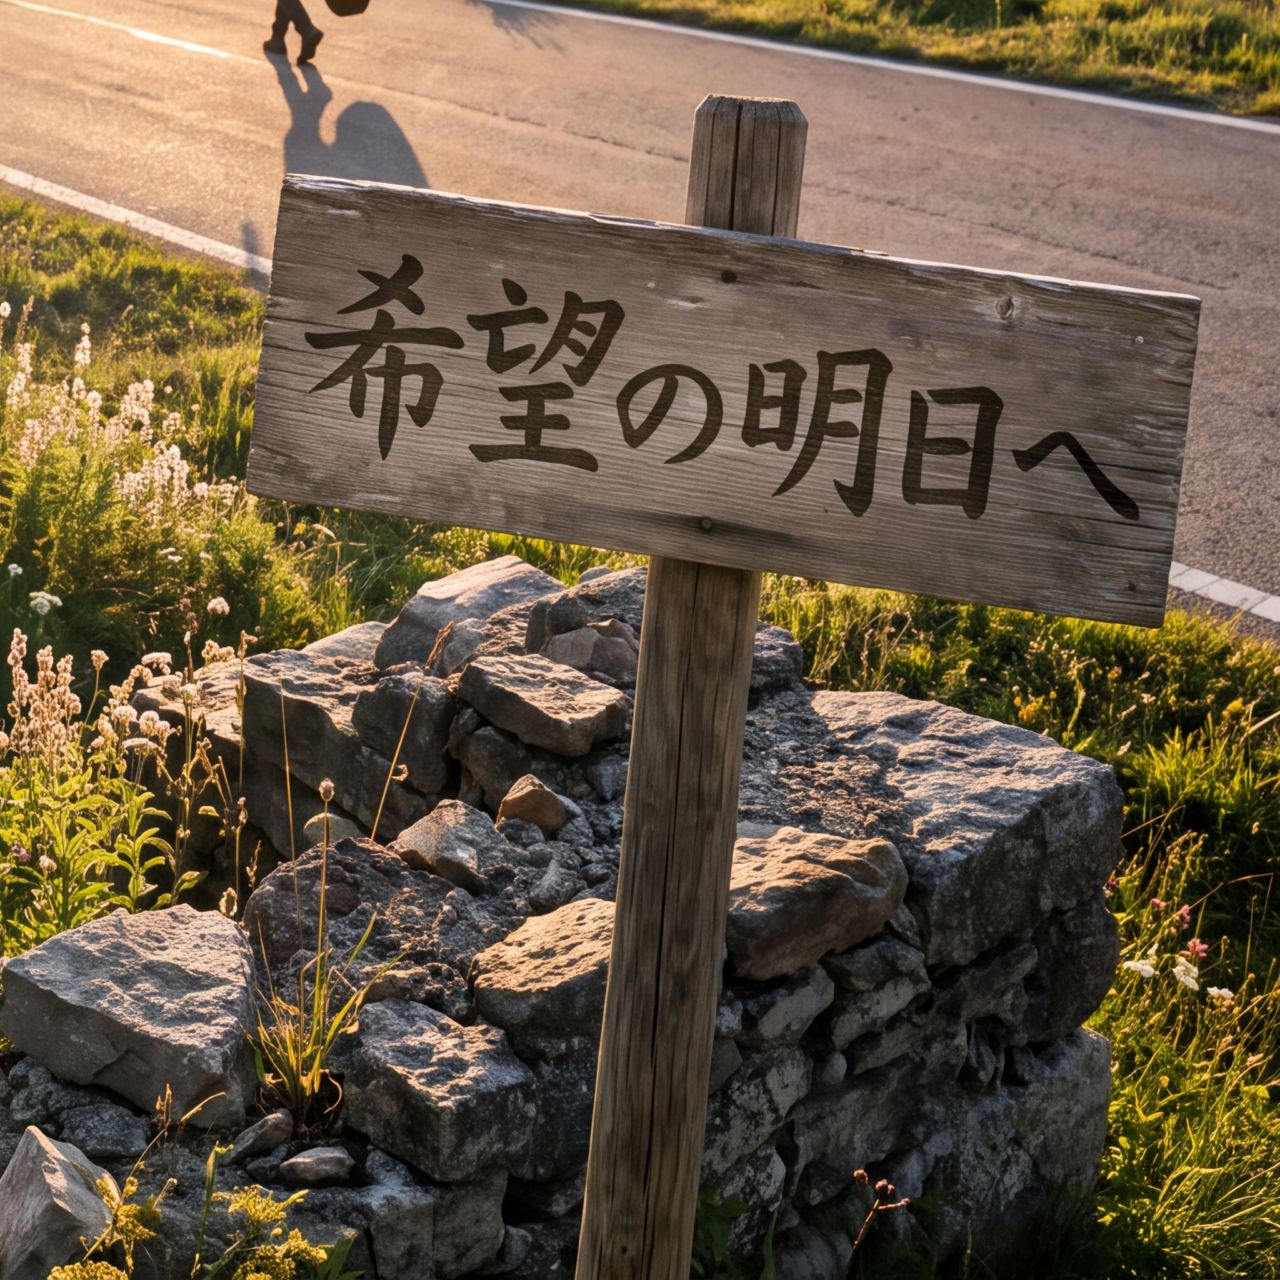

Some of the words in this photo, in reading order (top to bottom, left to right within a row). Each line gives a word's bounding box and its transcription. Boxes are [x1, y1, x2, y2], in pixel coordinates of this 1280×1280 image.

[304, 254, 1140, 520] 希望の明日へ
